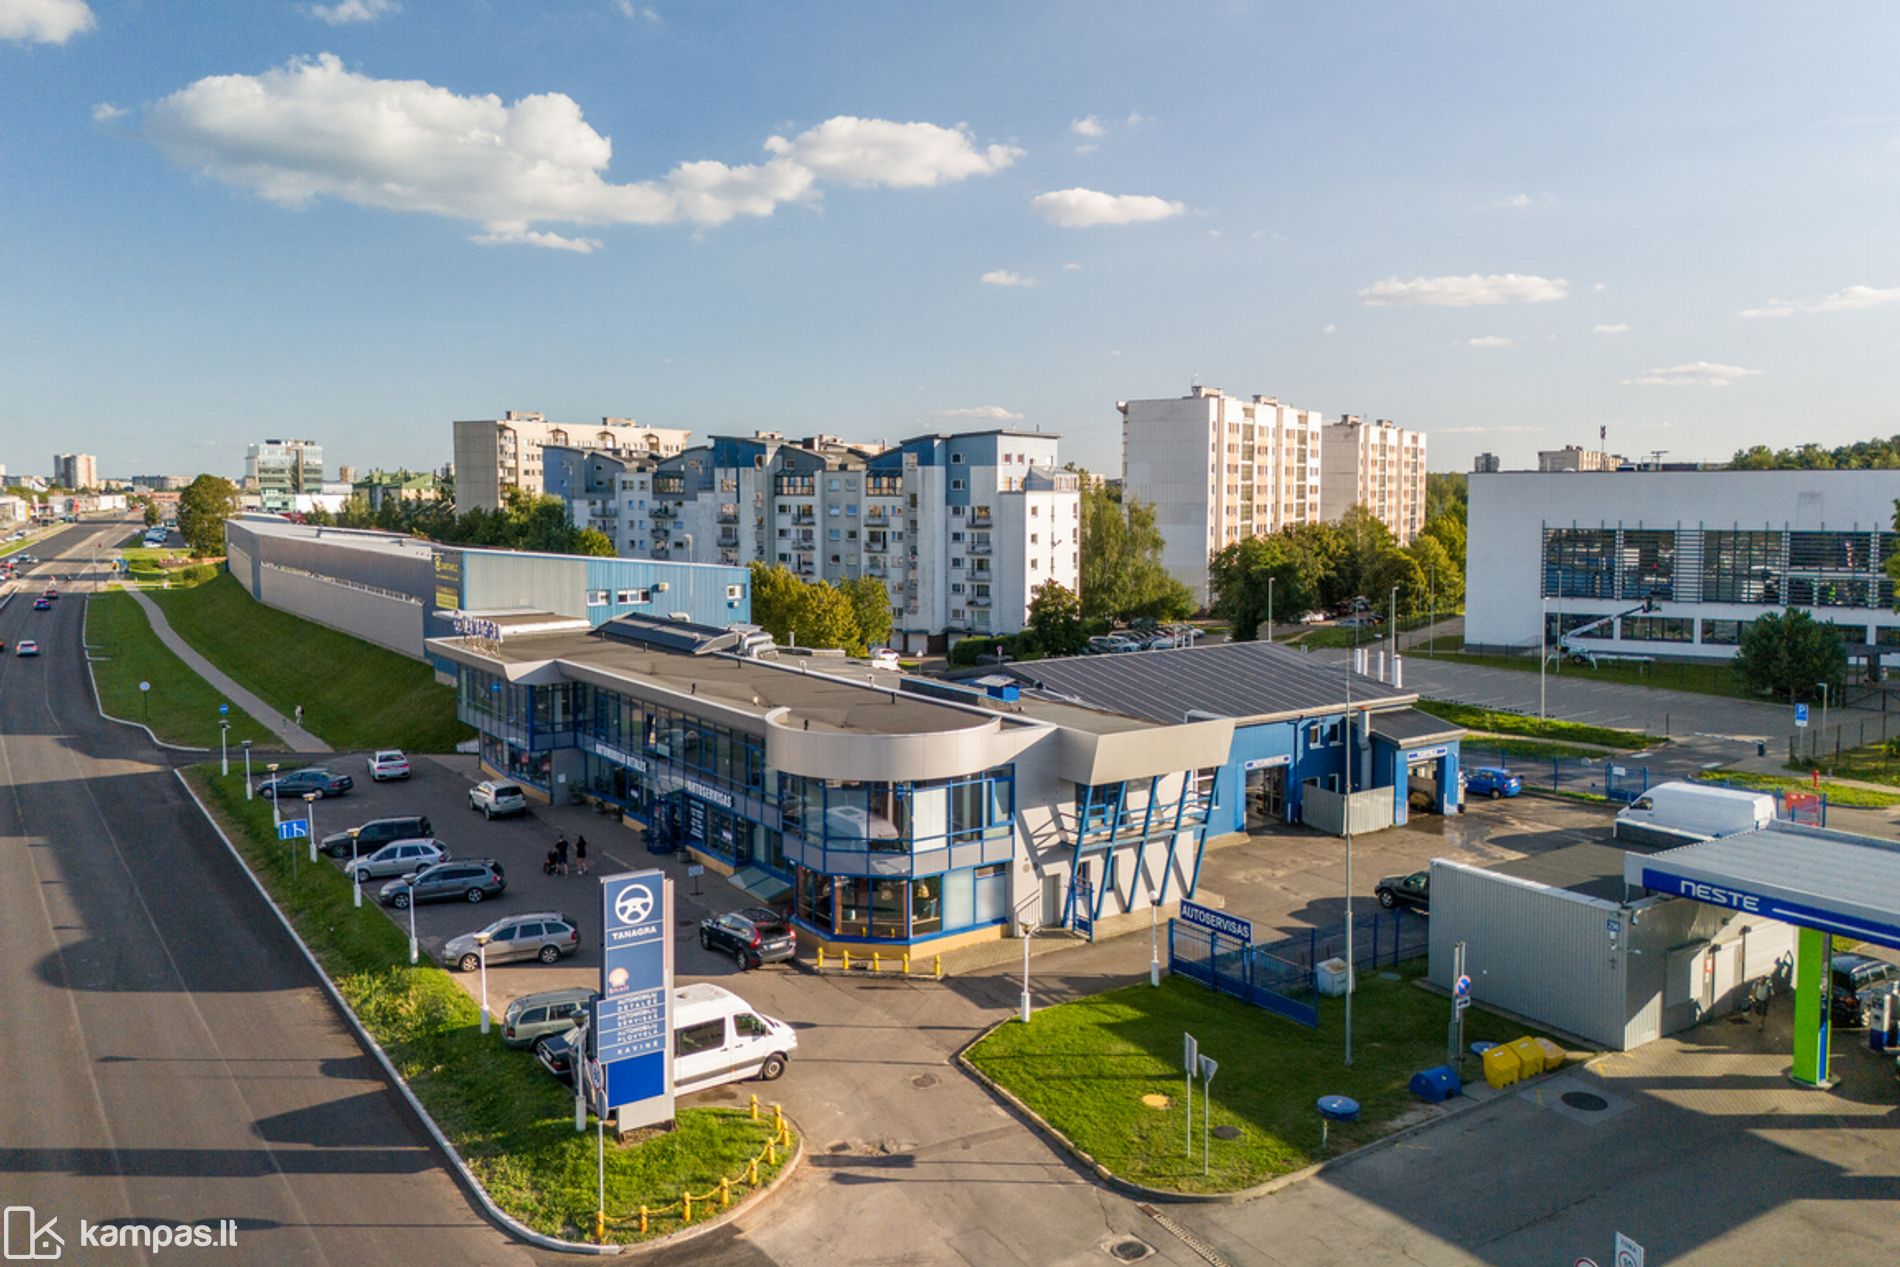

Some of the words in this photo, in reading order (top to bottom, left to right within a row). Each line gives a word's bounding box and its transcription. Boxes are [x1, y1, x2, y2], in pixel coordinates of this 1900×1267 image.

[1680, 880, 1760, 912] NESTE
[612, 926, 657, 940] TANAGRA
[1182, 904, 1250, 938] AUTOSERVISAS
